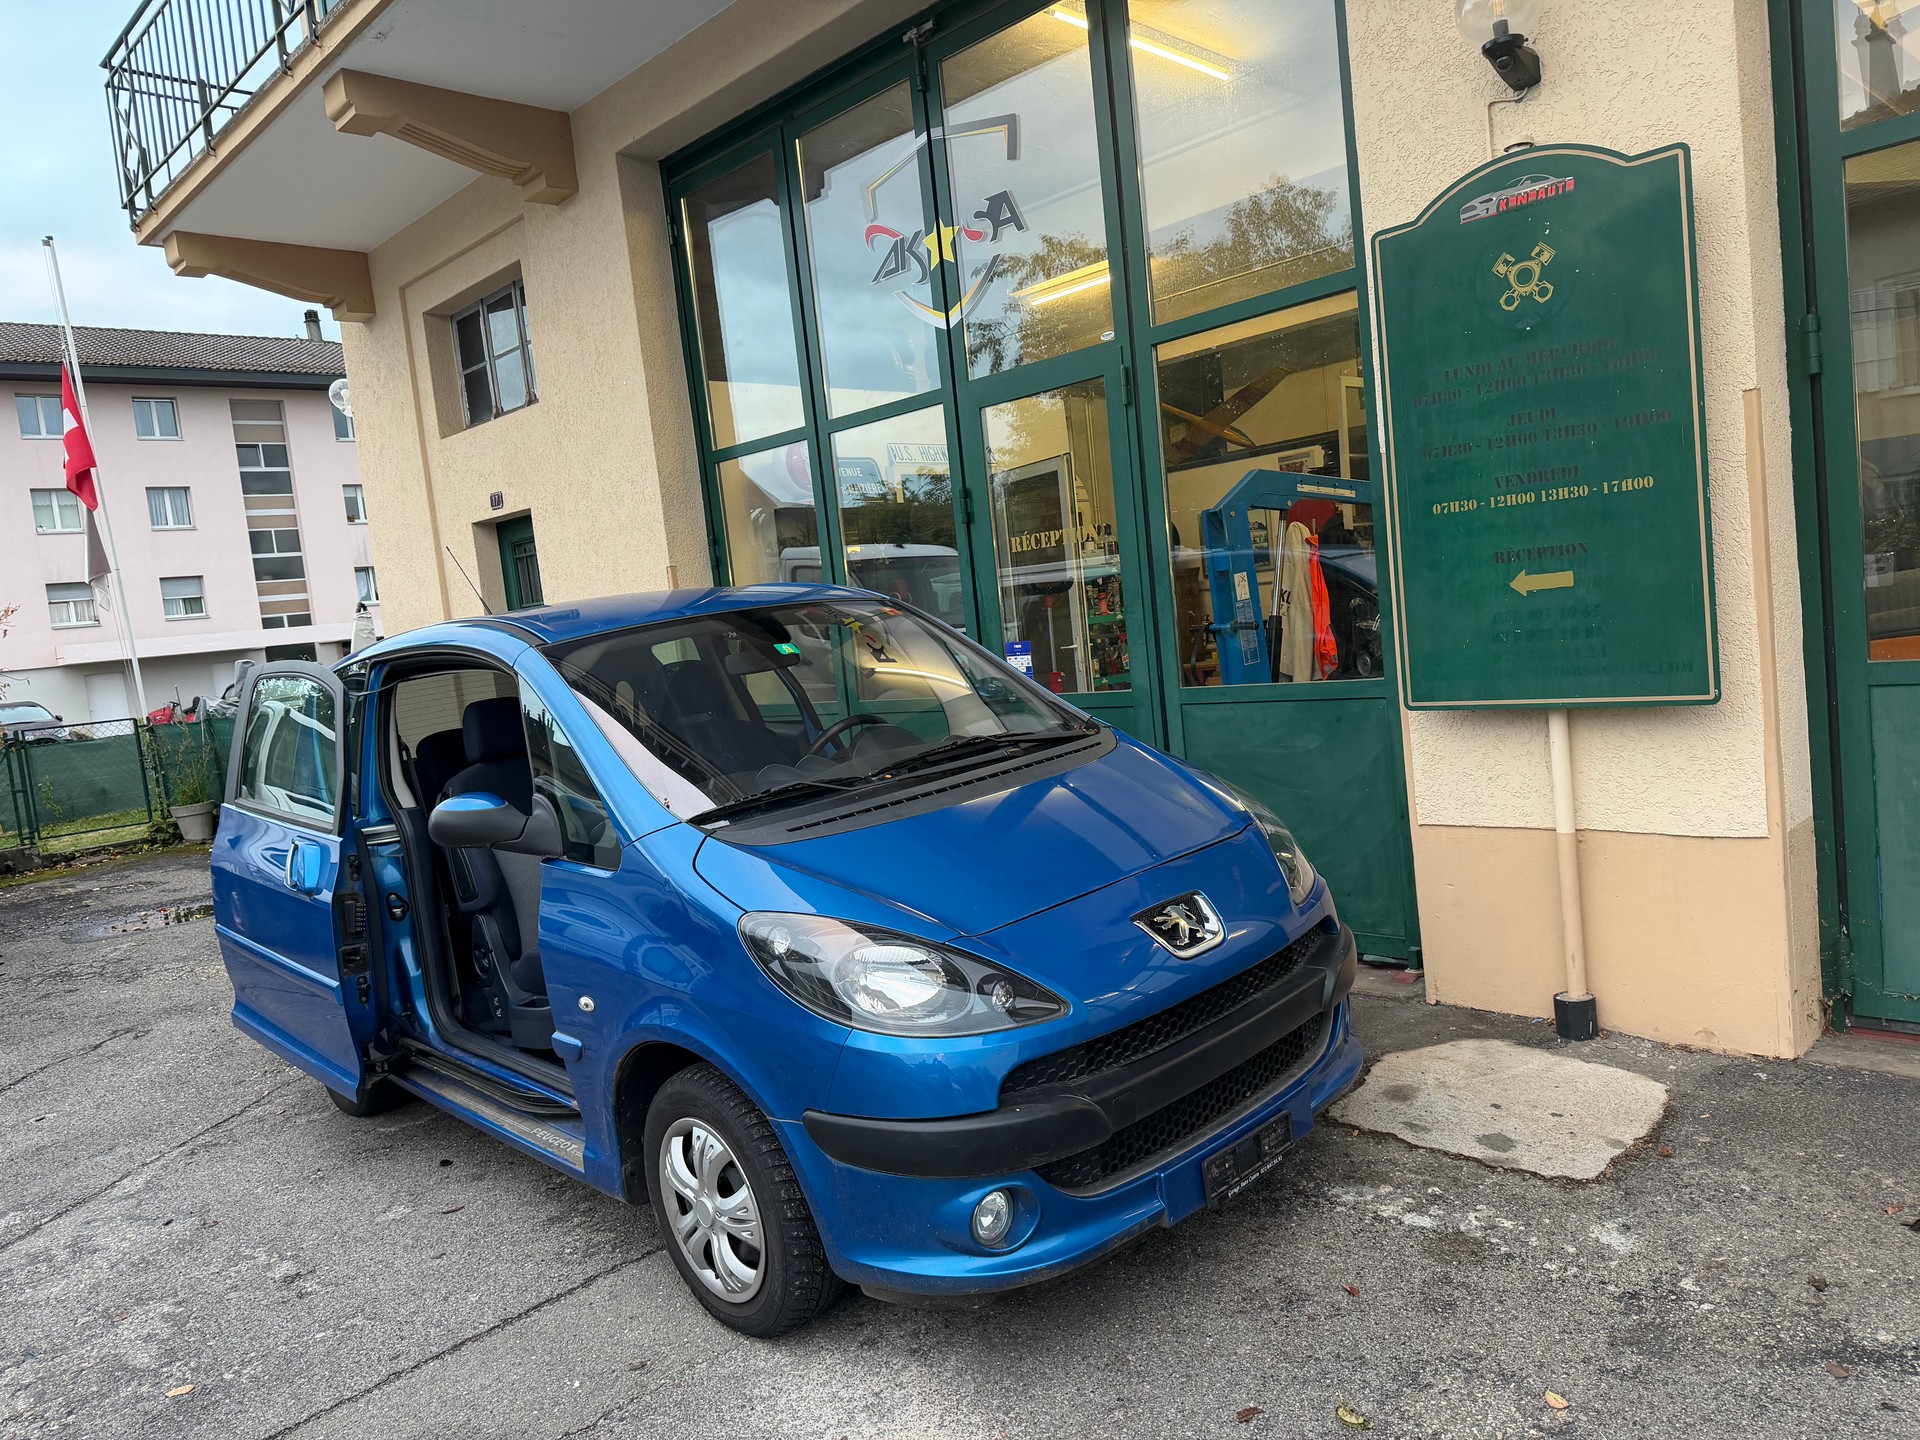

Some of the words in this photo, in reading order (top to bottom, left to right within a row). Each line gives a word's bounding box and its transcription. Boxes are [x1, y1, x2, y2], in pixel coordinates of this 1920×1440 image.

[1444, 361, 1494, 383] LUNDI
[1477, 374, 1527, 396] 12H00
[1507, 407, 1557, 427] JEUDI
[1487, 431, 1538, 451] 12H00
[1544, 421, 1597, 441] 13H30
[895, 445, 917, 462] U.S.
[1494, 465, 1578, 489] VENDREDI
[1432, 499, 1477, 515] 07H30
[1490, 491, 1536, 508] 12H00
[1540, 484, 1589, 502] 13H30
[1603, 475, 1654, 494] 17H00
[1010, 524, 1101, 553] RÉCEPTION
[1494, 541, 1588, 564] RÉCEPTION
[530, 1127, 577, 1152] PEUGEOT
